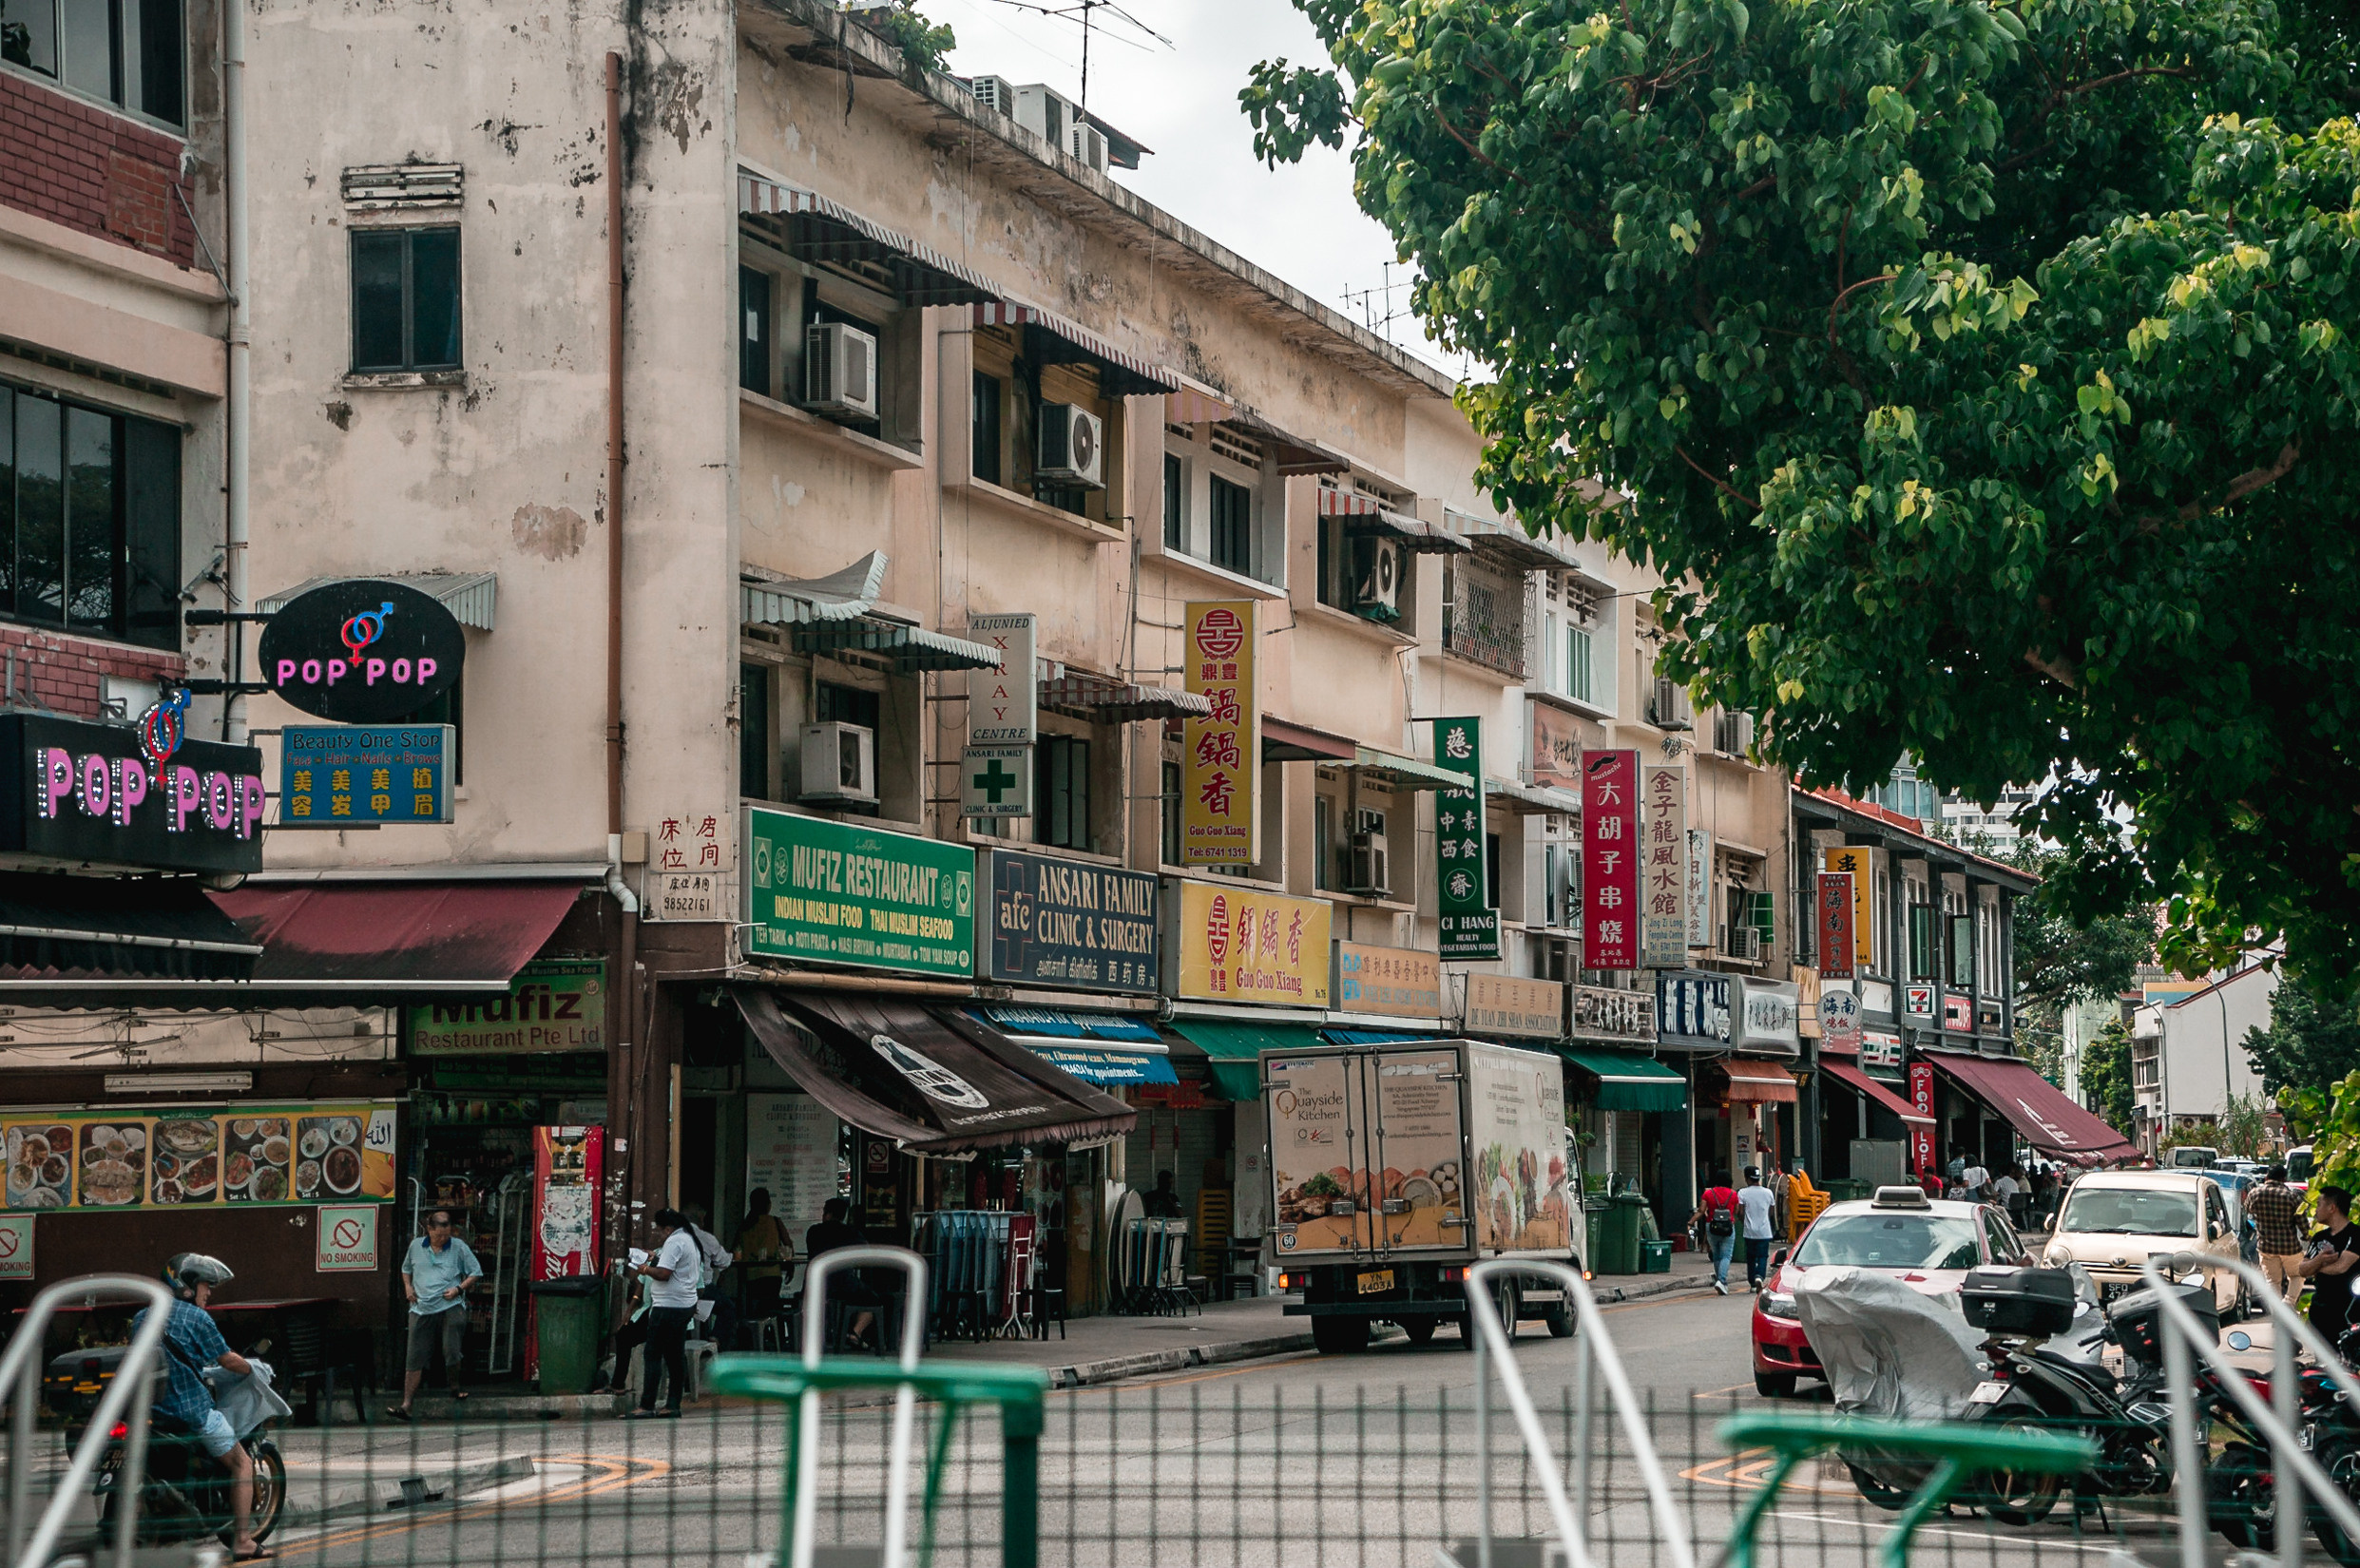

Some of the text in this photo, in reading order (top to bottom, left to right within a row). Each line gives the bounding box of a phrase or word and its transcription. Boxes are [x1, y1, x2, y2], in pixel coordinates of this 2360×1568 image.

[971, 618, 1029, 631] ALJUNIED
[278, 658, 437, 687] POP POP
[293, 732, 440, 750] Beauty One Stop
[972, 728, 1027, 739] CENTRE
[287, 752, 441, 766] Face Hair Nails Brows
[966, 749, 1023, 758] ANSARI FAMILY
[1590, 762, 1622, 782] mustache
[37, 747, 265, 840] POP POP
[965, 805, 1023, 814] CLINIC & SURGERY
[1189, 825, 1246, 838] Guo Guo Xiang
[1188, 847, 1247, 857] Tel: 6741 1319
[1650, 770, 1679, 916] 金子龍風水館
[1597, 781, 1623, 945] 大胡子串烧
[792, 845, 938, 908] MUFIZ RESTAURANT
[1038, 864, 1154, 917] ANSARI FAMILY
[664, 896, 710, 911] 98522161
[775, 895, 863, 928] INDIAN MUSLIM FOOD
[1000, 890, 1030, 931] afc
[870, 909, 953, 941] THAI MUSLIM SEAFOOD
[1037, 909, 1154, 954] CLINIC & SURGERY
[1441, 915, 1494, 930] CI HANG
[755, 926, 767, 944] TEH
[768, 927, 787, 947] TARIK
[796, 931, 810, 949] ROTI
[810, 933, 830, 951] PRATA
[944, 949, 958, 966] SOUP
[1456, 934, 1479, 943] HEALTY
[1440, 944, 1478, 952] VEGETARIAN
[531, 966, 597, 975] Muslim Sea Food
[1236, 966, 1302, 997] Guo Guo Xiang
[432, 984, 583, 1024] Mufiz
[1823, 998, 1856, 1016] 海南
[1525, 1013, 1558, 1032] ASSOCIATION
[414, 1024, 599, 1049] Restaurant Pte Ltd
[1054, 1051, 1087, 1062] Ultrasound
[1105, 1053, 1150, 1065] Mammograms
[1297, 1087, 1311, 1096] The
[1916, 1080, 1928, 1114] FOO
[1276, 1090, 1343, 1119] Quayside
[1297, 1109, 1340, 1121] Kitchen
[1919, 1131, 1930, 1167] LOF
[1283, 1235, 1294, 1245] 60
[0, 1261, 31, 1272] MOKING
[320, 1252, 374, 1263] NO SMOKING
[1370, 1272, 1382, 1281] YN
[2108, 1283, 2128, 1291] SFQ
